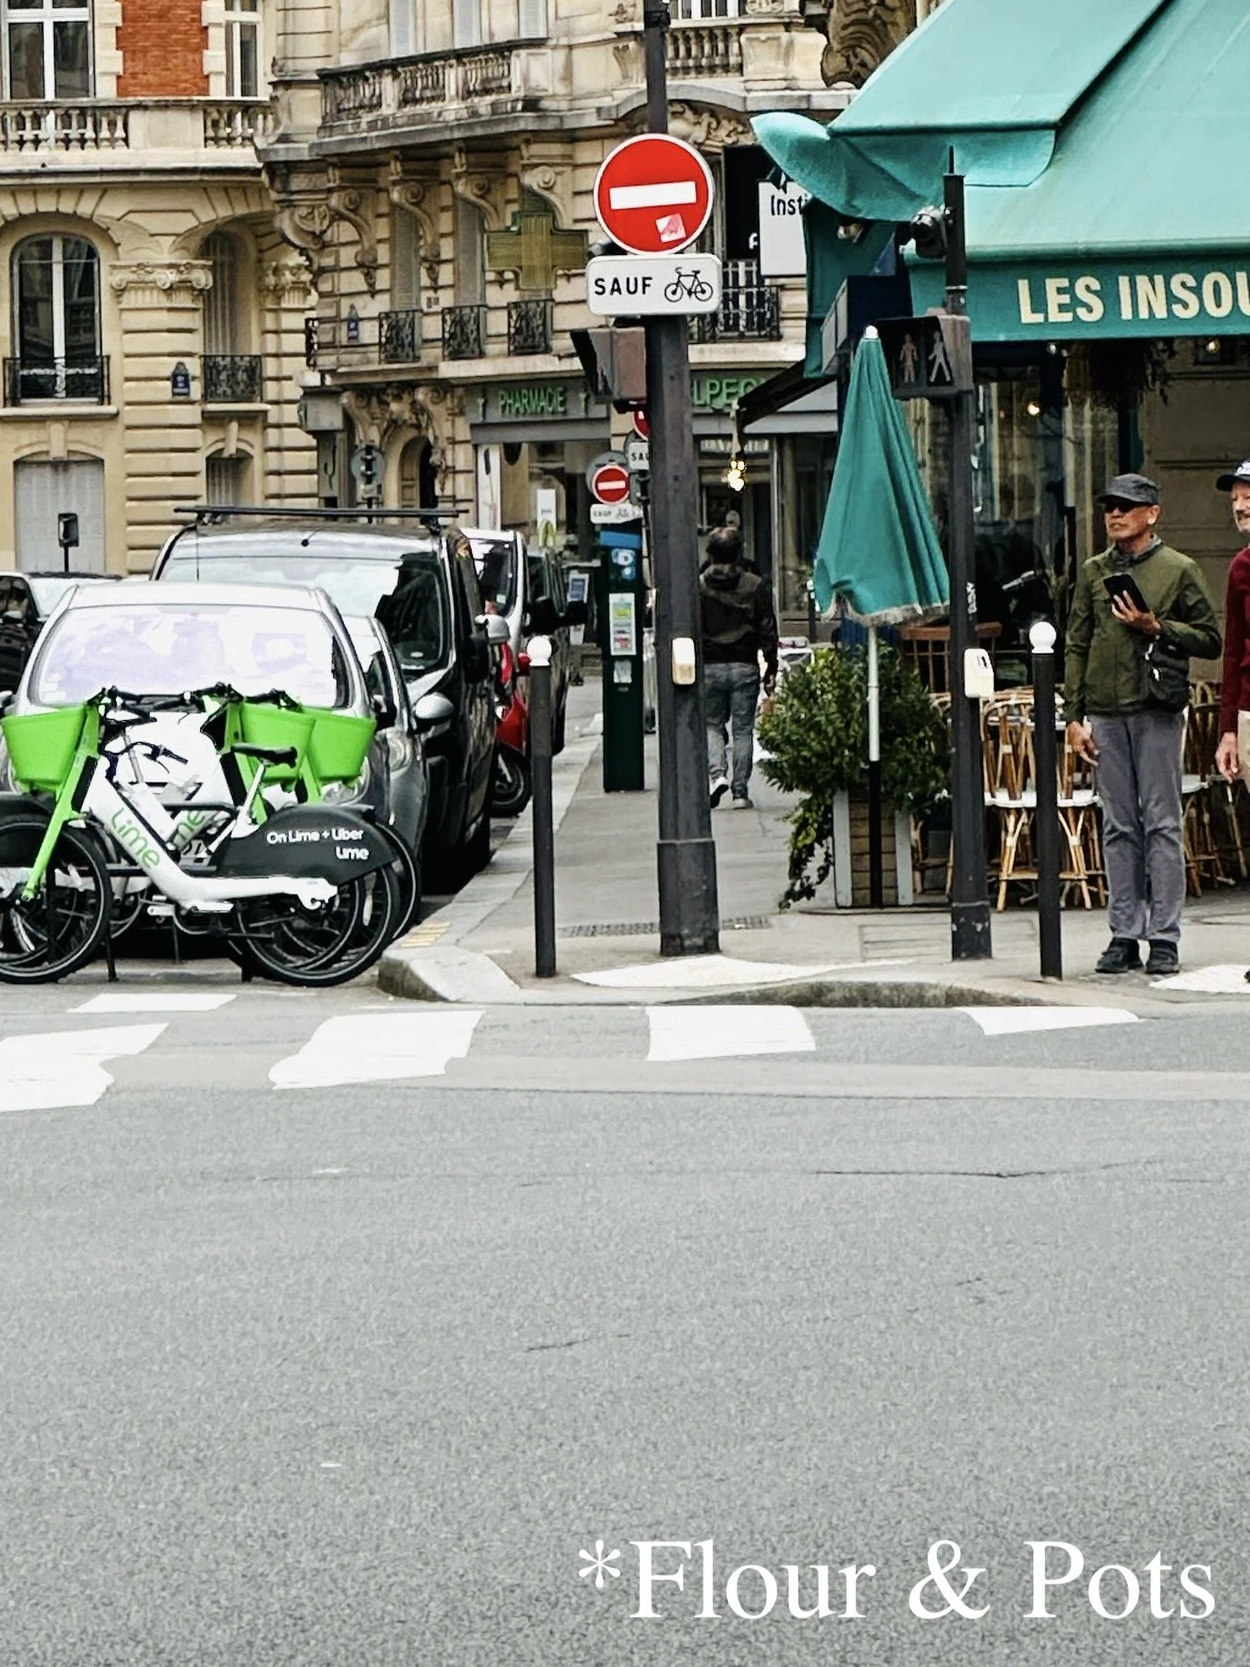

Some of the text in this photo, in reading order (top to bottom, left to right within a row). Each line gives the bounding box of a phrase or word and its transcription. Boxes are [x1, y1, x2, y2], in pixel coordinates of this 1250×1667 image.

[594, 276, 653, 296] SAUF
[1017, 275, 1104, 324] LES
[498, 387, 566, 415] PHARMACIE
[111, 807, 160, 869] Lime
[266, 831, 288, 845] On
[288, 830, 321, 843] Lime
[331, 828, 365, 841] Uber
[335, 846, 370, 860] Lime
